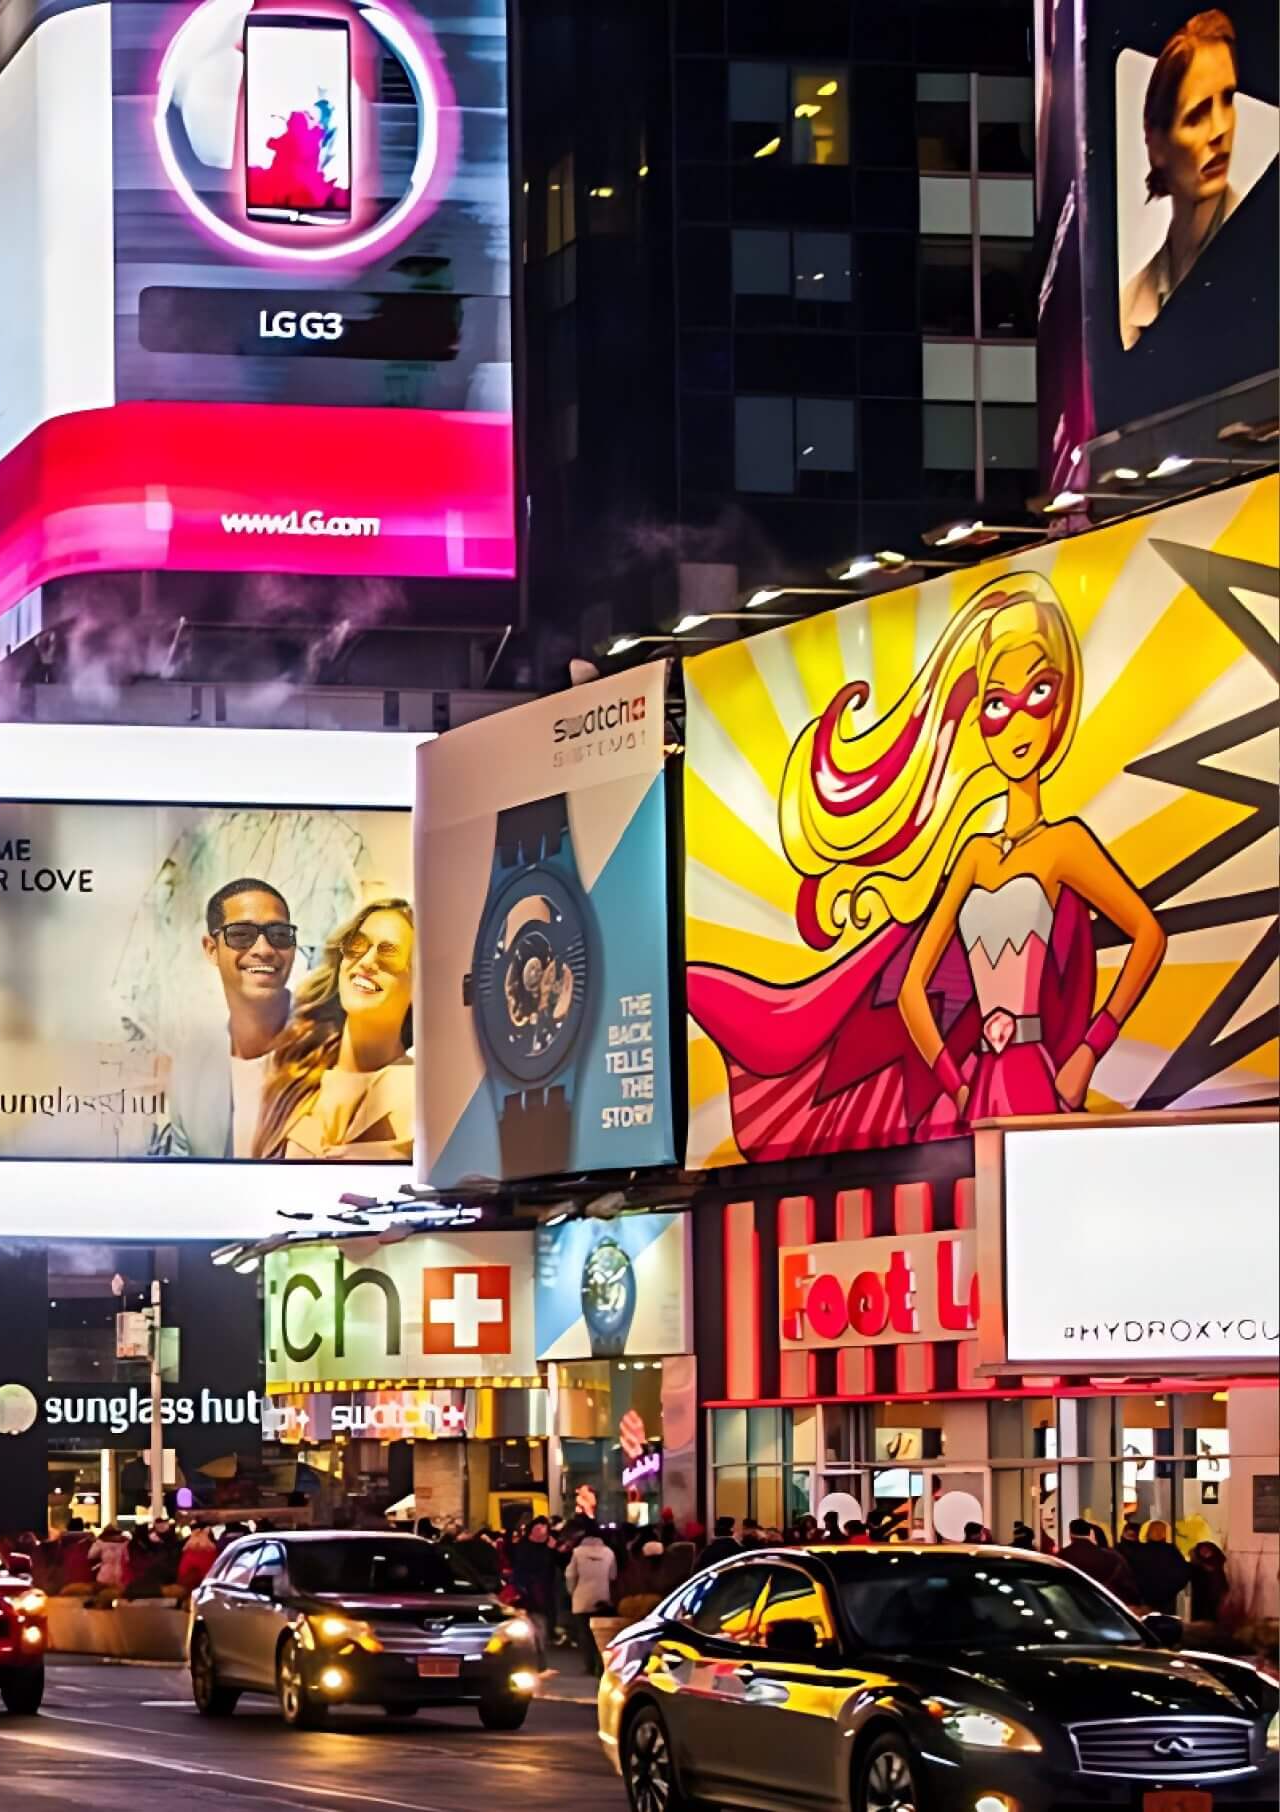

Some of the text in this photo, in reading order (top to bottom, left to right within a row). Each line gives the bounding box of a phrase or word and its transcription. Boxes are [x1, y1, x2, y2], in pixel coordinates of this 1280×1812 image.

[260, 310, 344, 340] LG G3
[21, 869, 94, 893] LOVE
[620, 993, 652, 1017] THE
[608, 1021, 653, 1046] BACK
[605, 1048, 654, 1074] TELLS
[621, 1075, 654, 1099] THE
[601, 1103, 654, 1129] STORY
[270, 1250, 402, 1363] ch
[783, 1251, 920, 1341] Foot
[45, 1387, 194, 1434] sunglass
[200, 1388, 264, 1425] hut
[331, 1401, 439, 1434] swatch
